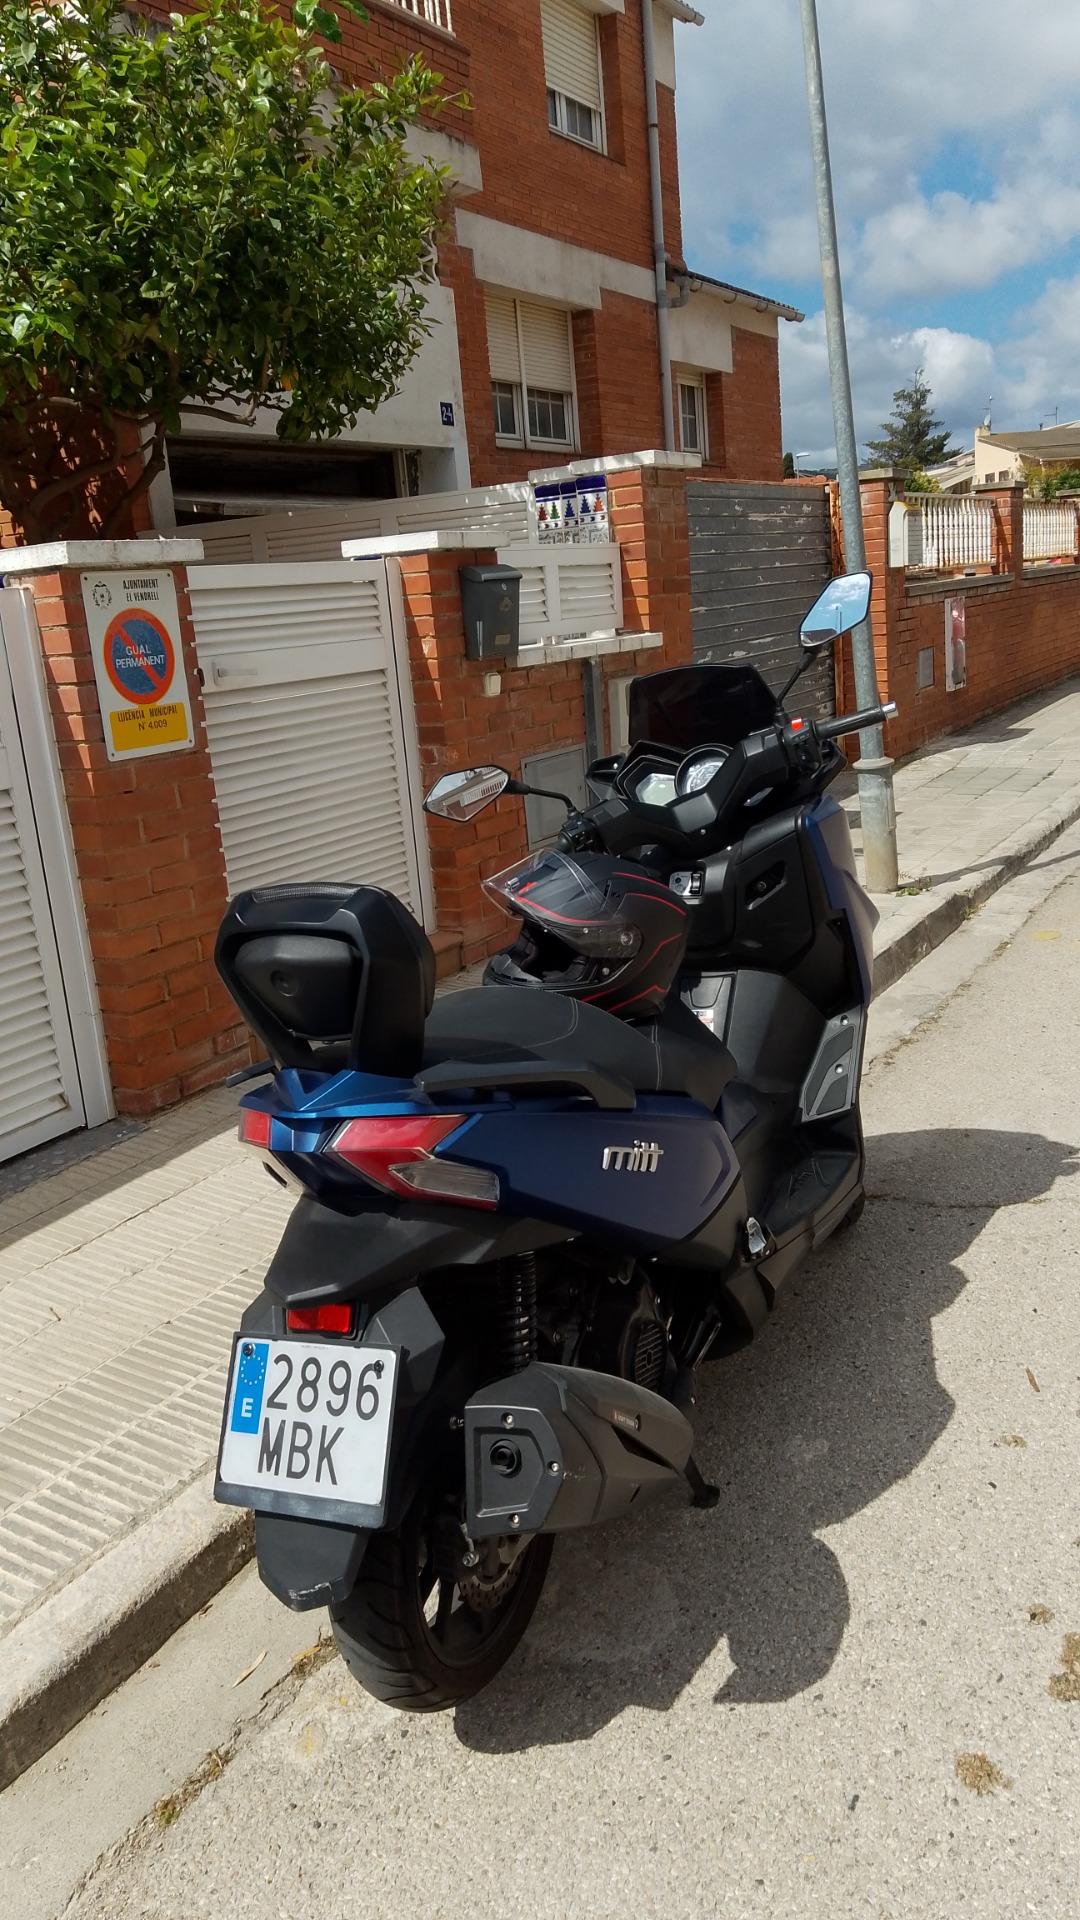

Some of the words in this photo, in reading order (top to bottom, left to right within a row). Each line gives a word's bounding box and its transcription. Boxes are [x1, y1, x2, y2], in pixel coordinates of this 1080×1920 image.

[442, 406, 453, 422] 24
[123, 579, 159, 590] AJUNTAMENT
[127, 593, 133, 602] EL
[134, 591, 160, 602] VENDRELL
[125, 644, 152, 656] GUAL
[116, 655, 165, 668] PERMANENT
[149, 704, 178, 717] MUNICIPAL
[602, 1140, 664, 1172] mitt
[266, 1353, 383, 1421] 2896
[241, 1397, 254, 1418] E
[258, 1417, 345, 1486] MBK
